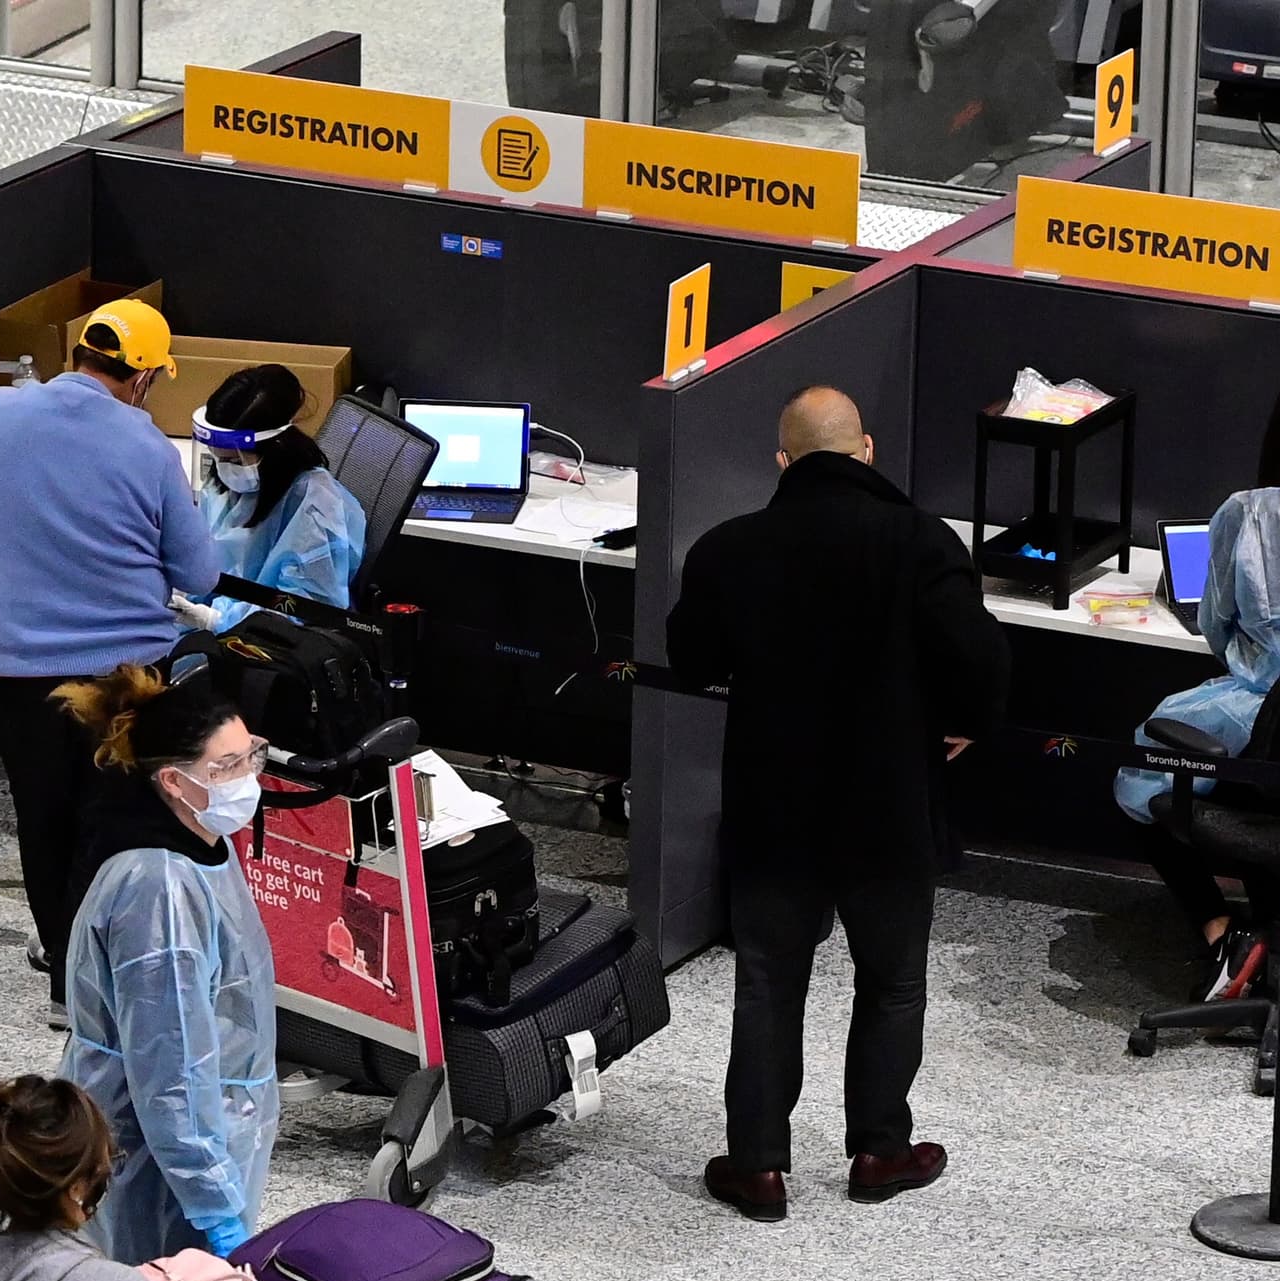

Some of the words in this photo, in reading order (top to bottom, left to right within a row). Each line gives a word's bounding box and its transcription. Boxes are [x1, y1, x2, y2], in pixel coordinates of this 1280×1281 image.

[1108, 74, 1124, 128] 9
[213, 105, 418, 155] REGISTRATION
[626, 161, 815, 209] INSCRIPTION
[1046, 218, 1269, 272] REGISTRATION
[684, 293, 694, 348] 1
[346, 617, 371, 633] Toronto
[495, 641, 541, 659] bienvenue
[1145, 753, 1180, 767] Toronto
[1181, 757, 1216, 772] Pearson
[246, 863, 263, 882] to
[266, 873, 291, 892] get
[293, 882, 320, 903] you
[294, 863, 324, 885] cart
[249, 885, 289, 910] there
